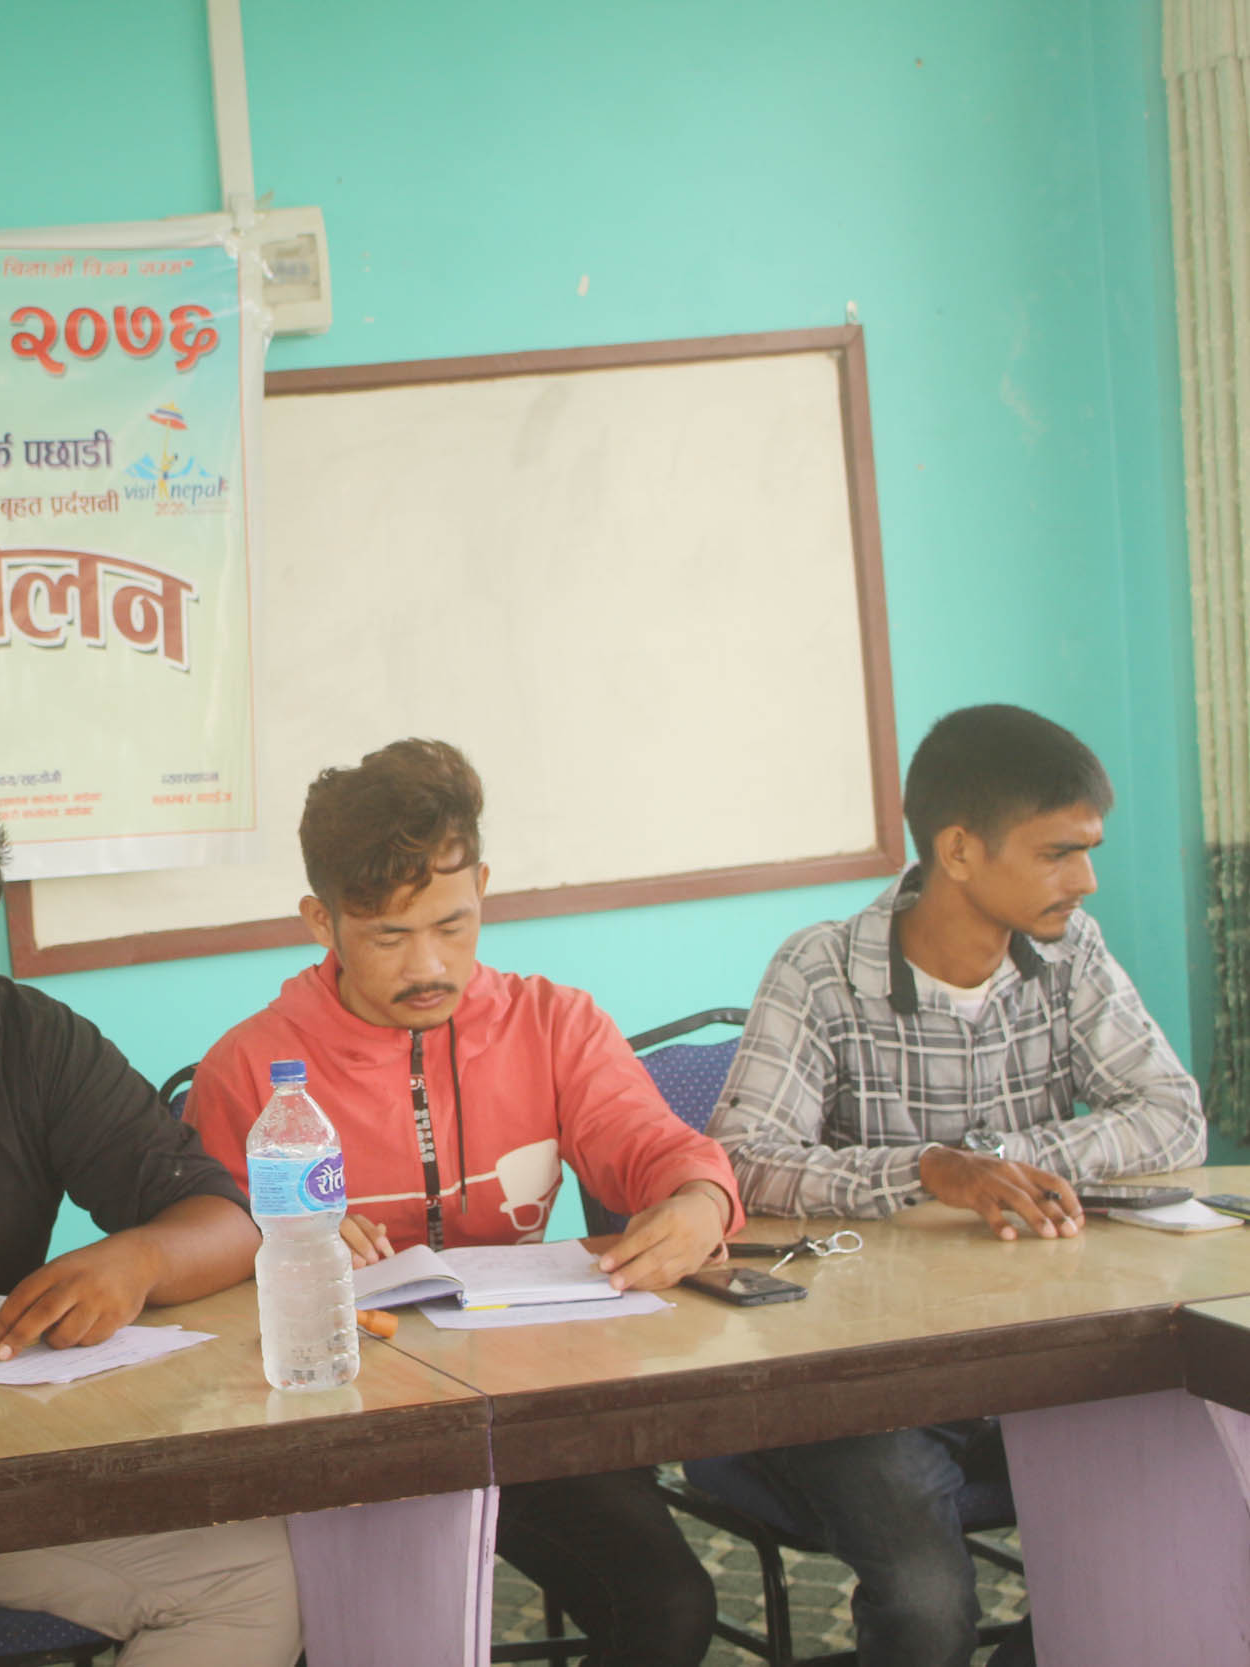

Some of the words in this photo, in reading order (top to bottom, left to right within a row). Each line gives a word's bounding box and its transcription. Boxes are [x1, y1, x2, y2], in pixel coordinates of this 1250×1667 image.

[10, 303, 219, 373] २०७६
[22, 428, 114, 470] पछाडी
[315, 1164, 345, 1195] रौत
